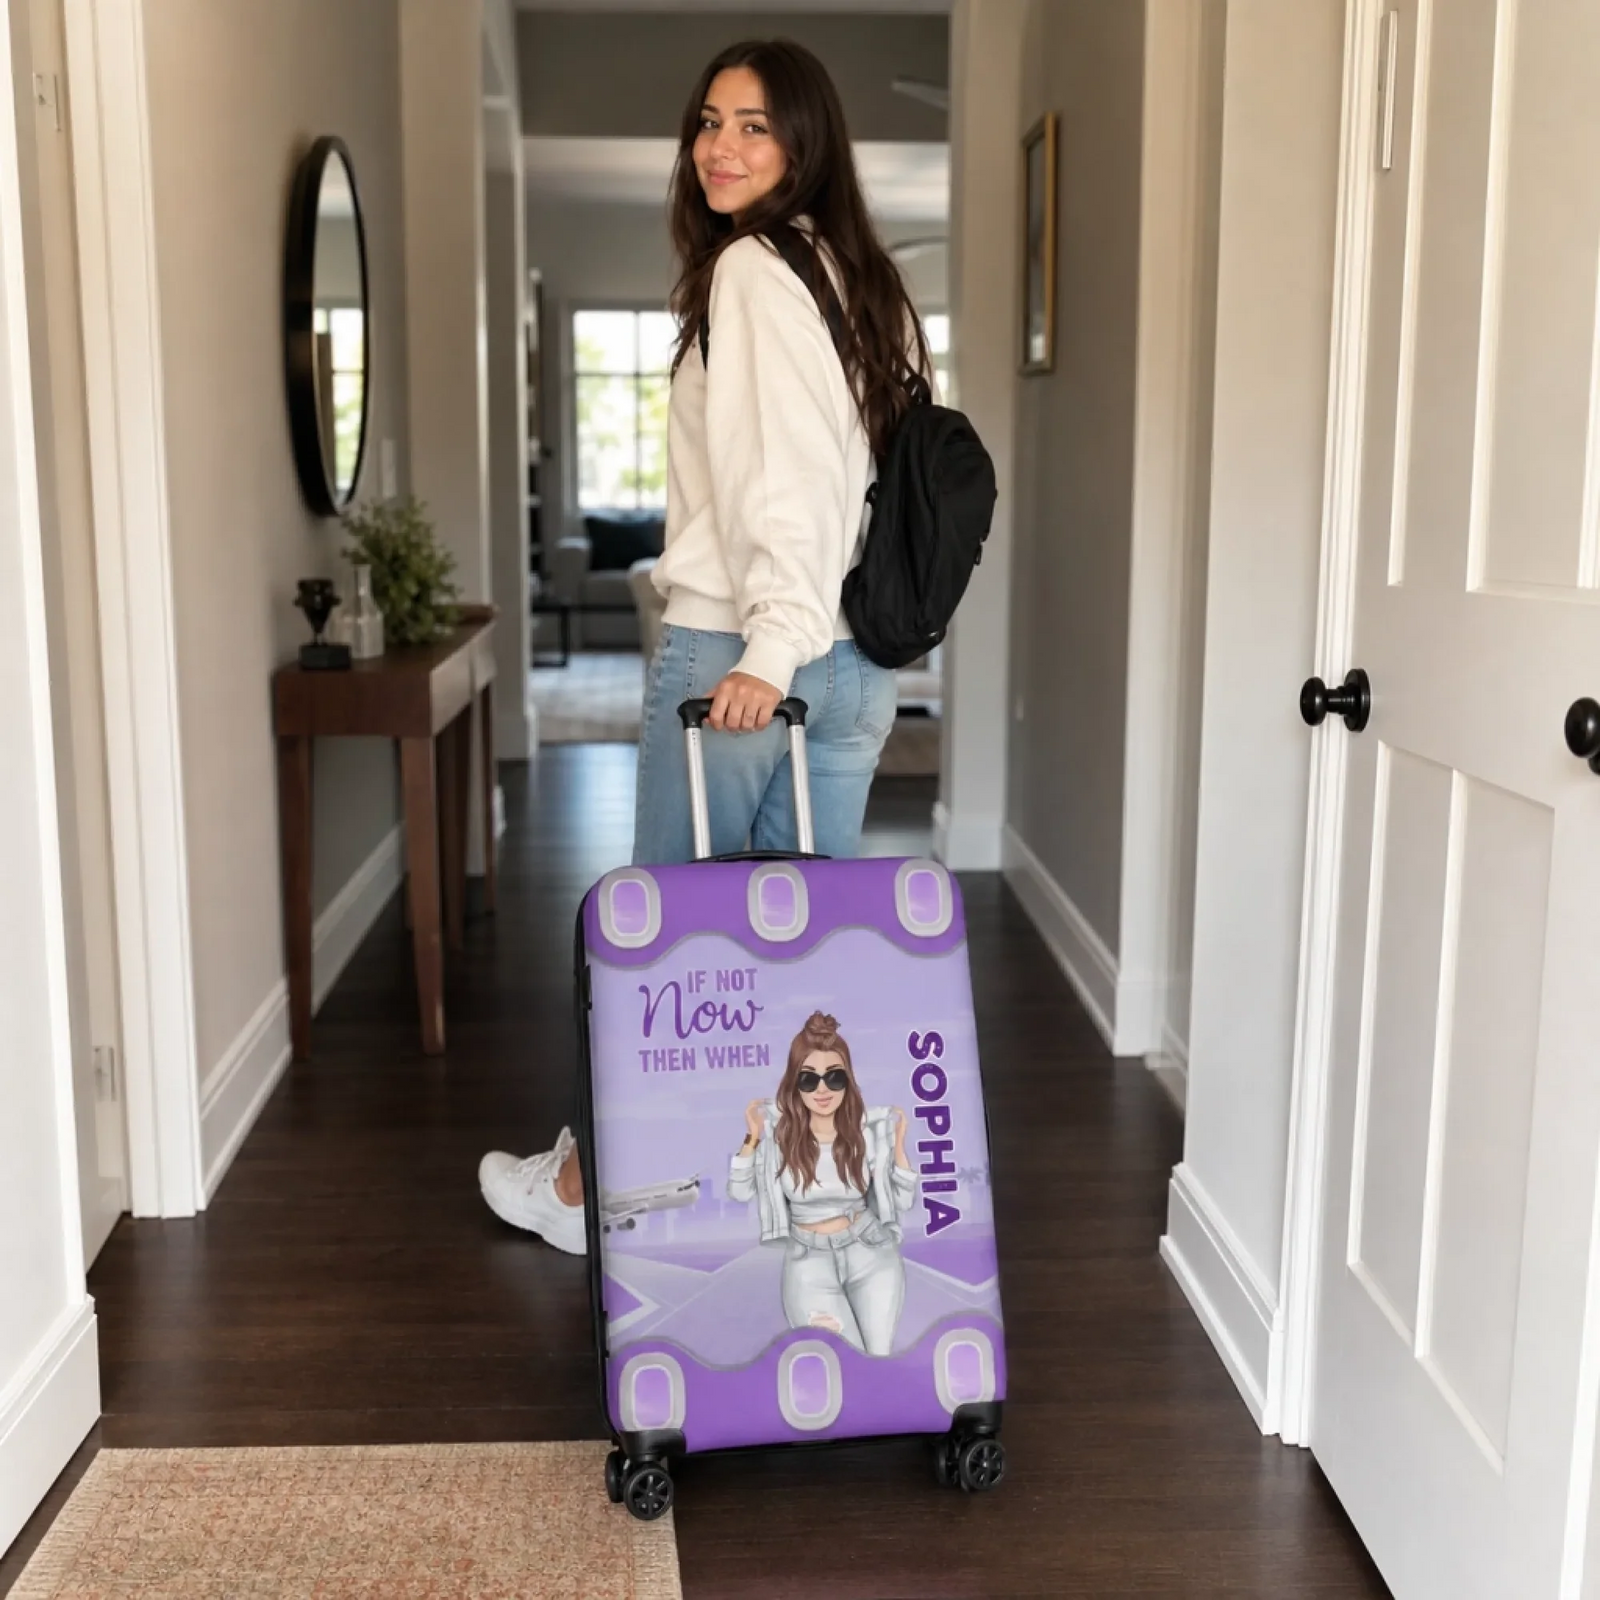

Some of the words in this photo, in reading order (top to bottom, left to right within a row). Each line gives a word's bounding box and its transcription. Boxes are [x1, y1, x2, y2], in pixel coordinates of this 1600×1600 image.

[687, 970, 707, 993] IF
[716, 968, 757, 992] NOT
[638, 980, 765, 1040] Now
[638, 1047, 696, 1073] THEN
[704, 1043, 770, 1069] WHEN
[908, 1030, 961, 1236] SOPHIA
